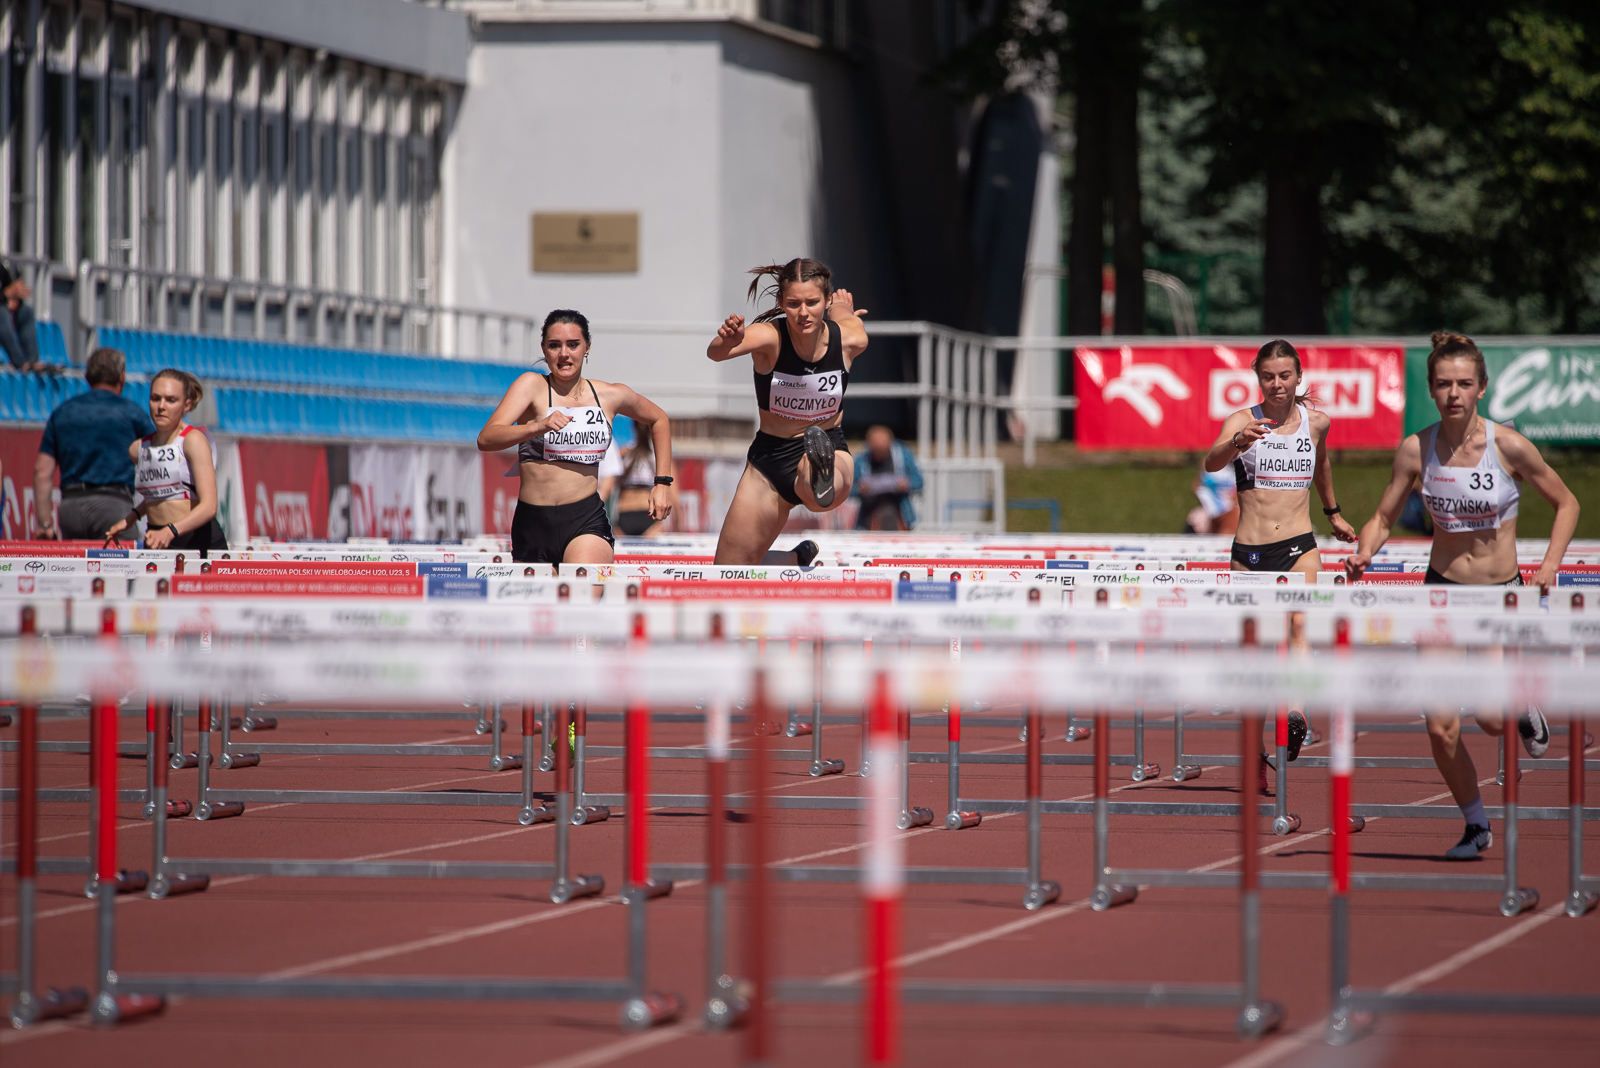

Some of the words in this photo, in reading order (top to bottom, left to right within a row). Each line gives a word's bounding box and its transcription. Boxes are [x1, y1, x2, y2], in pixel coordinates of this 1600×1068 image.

[777, 380, 807, 388] TOTALbet
[818, 375, 838, 392] 29
[1224, 381, 1360, 408] OEN
[774, 396, 837, 411] KUCZMYŁO
[586, 409, 604, 424] 24
[548, 431, 607, 445] DZIAŁOWSKA
[1296, 438, 1312, 452] 25
[157, 448, 175, 461] 23
[1259, 458, 1312, 472] HAGLAUER
[1260, 480, 1292, 488] WARSZAWA
[1469, 472, 1494, 490] 33
[1426, 495, 1492, 514] PERZYŃSKA
[674, 572, 708, 581] FUEL
[720, 569, 768, 580] TOTALbet
[1092, 573, 1141, 584] TOTALbet
[1216, 590, 1259, 606] FUEL
[1275, 589, 1335, 604] TOTALbet
